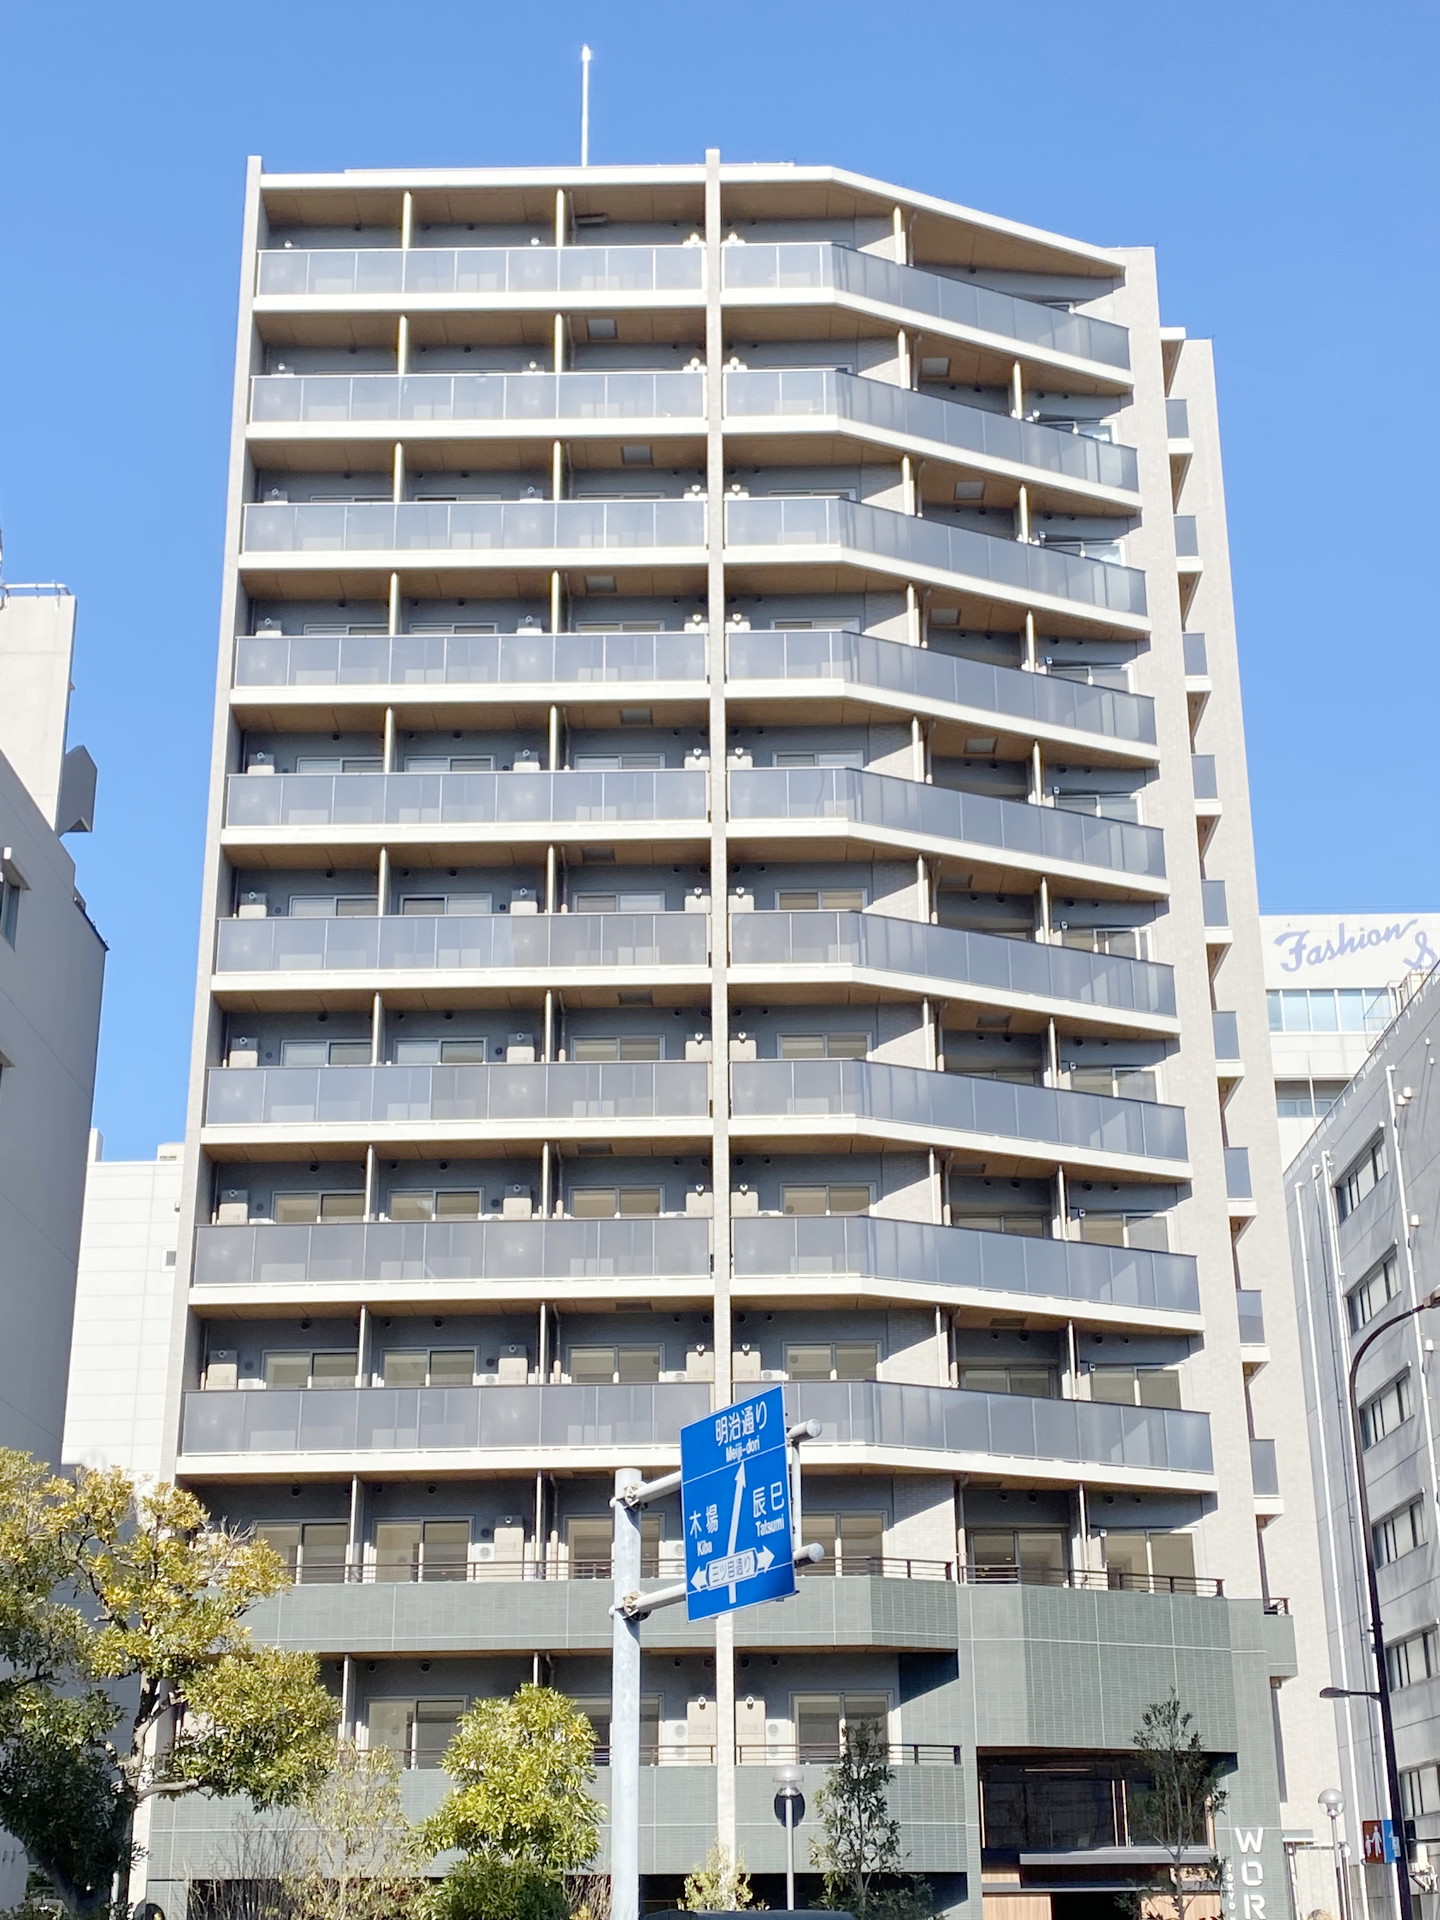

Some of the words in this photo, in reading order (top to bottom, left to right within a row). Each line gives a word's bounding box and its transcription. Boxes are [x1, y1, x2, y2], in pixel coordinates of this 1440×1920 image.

[1273, 919, 1418, 972] Fashion
[715, 1401, 768, 1447] 明治通り
[725, 1434, 760, 1463] Meiji-dori
[753, 1481, 785, 1518] 辰巳
[689, 1502, 719, 1539] 木場
[755, 1513, 785, 1538] Tatsumi
[697, 1540, 713, 1557] Kiba
[711, 1556, 752, 1583] 三ツ目通り
[1226, 1863, 1236, 1911] TOKYO
